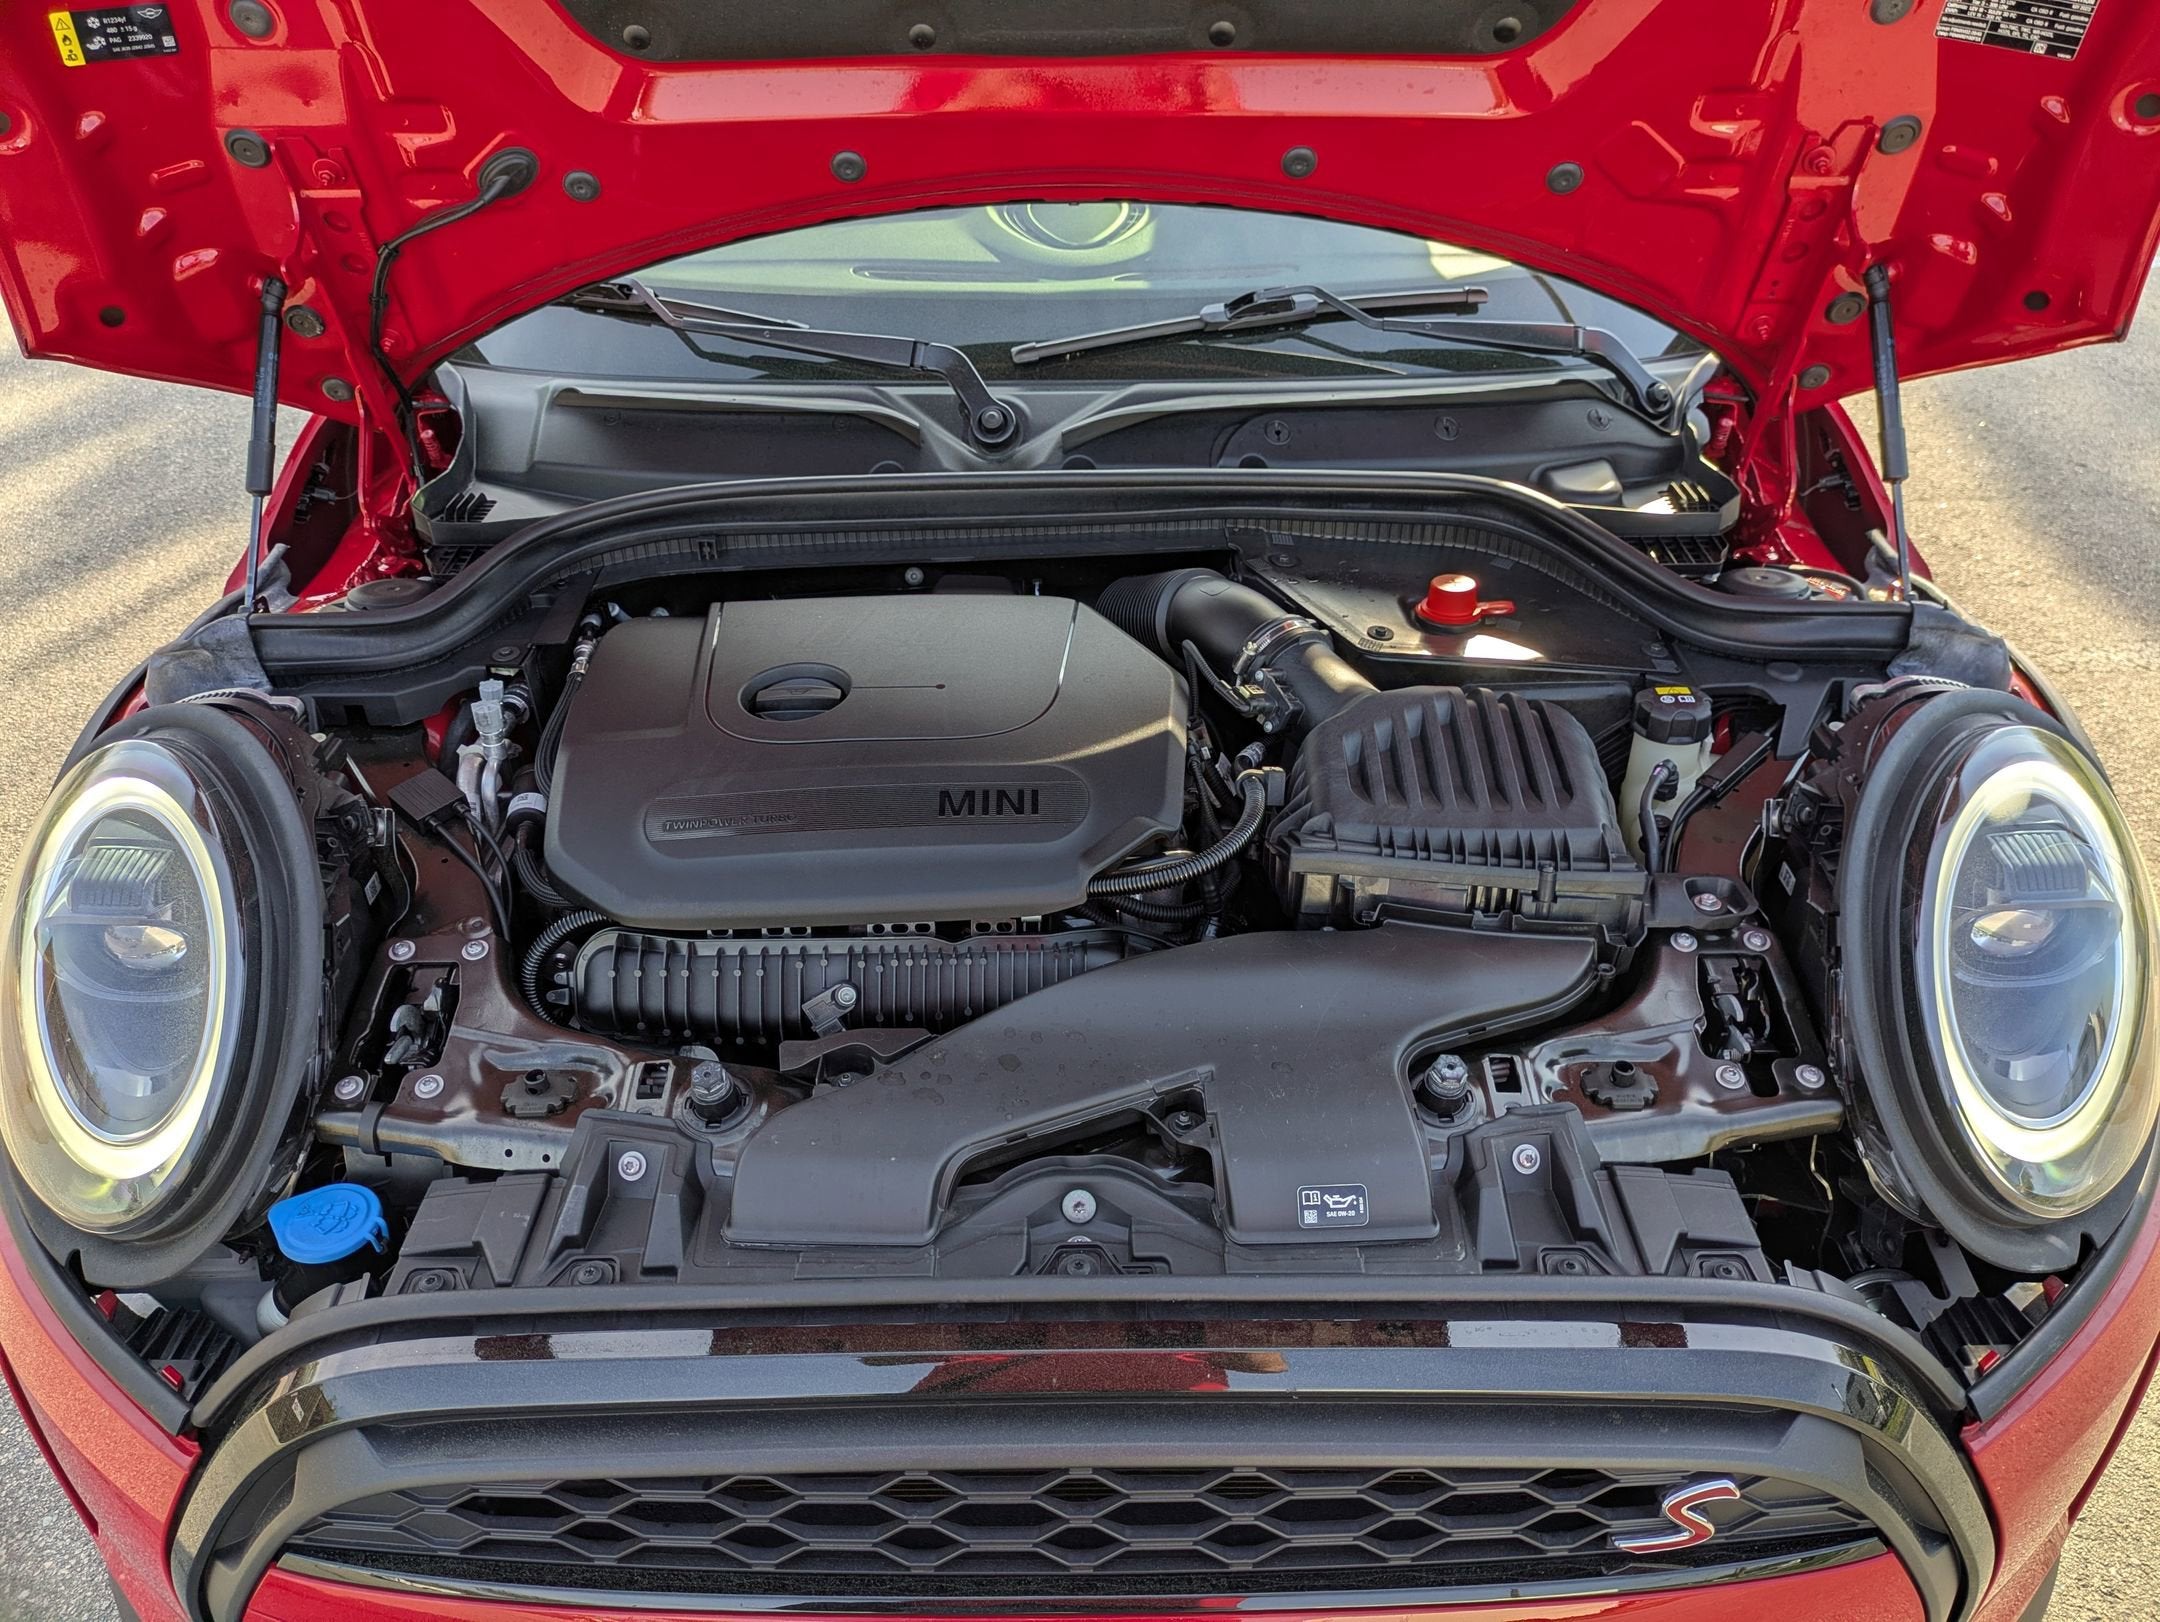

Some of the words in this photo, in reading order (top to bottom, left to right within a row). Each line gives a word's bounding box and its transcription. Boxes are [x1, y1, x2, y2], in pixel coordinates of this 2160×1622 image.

[106, 26, 118, 34] 480
[938, 789, 1040, 817] MINI
[664, 815, 749, 832] TWINPOWER
[752, 812, 798, 825] TURBO
[1612, 1479, 1740, 1554] S
